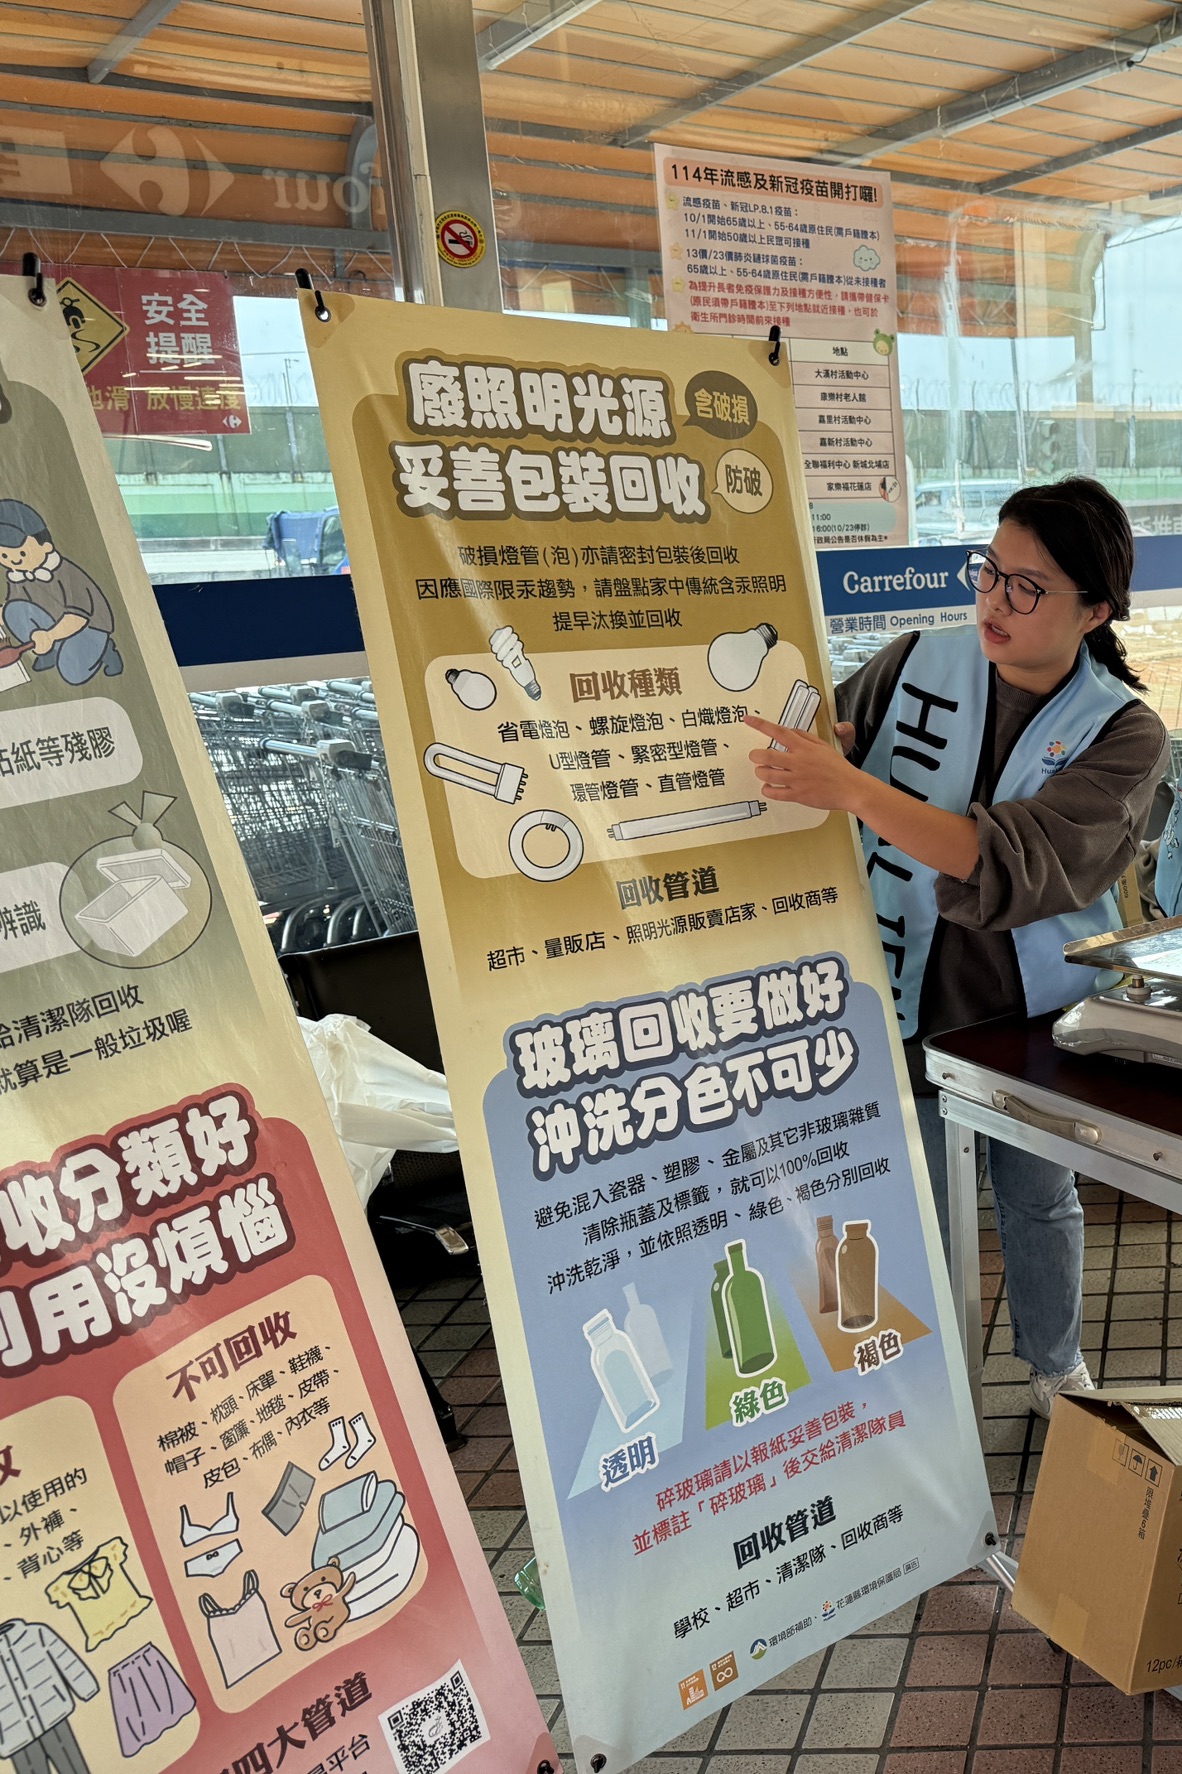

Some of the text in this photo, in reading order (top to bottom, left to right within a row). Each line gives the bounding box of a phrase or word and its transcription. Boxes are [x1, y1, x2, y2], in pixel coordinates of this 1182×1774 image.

[671, 163, 878, 203] 114年流感及新冠疫苗開打囉!
[141, 292, 209, 326] 安全
[146, 331, 215, 365] 提醒
[832, 346, 849, 357] 地點
[408, 359, 672, 439] 廢照明光源
[694, 388, 751, 426] 含破損
[394, 444, 706, 515] 妥善包裝回收
[725, 464, 763, 498] 防破
[458, 545, 740, 568] 破損燈管(泡)亦請密封包裝後回收
[842, 566, 949, 595] Carrefour
[552, 608, 683, 632] 提早汰換並回收
[830, 611, 968, 635] 營業時間 Opening Hours
[569, 667, 683, 703] 回收種類
[616, 866, 720, 910] 回收管道
[487, 886, 839, 972] 超市、量販店、照明光源販賣店家、回收商等
[514, 960, 844, 1090] 玻璃回收要做好
[533, 1030, 855, 1173] 沖洗分色不可少
[0, 1095, 251, 1257] 收分類好
[534, 1100, 881, 1230] 避免混入瓷器、塑膠、金屬及其它非玻璃雜質
[165, 1310, 298, 1403] 不可回收
[855, 1331, 902, 1373] 褐色
[732, 1379, 787, 1424] 綠色
[600, 1436, 656, 1488] 透明
[732, 1495, 837, 1570] 回收管道
[673, 1504, 904, 1640] 學校、超市、清潔隊、回收商等
[219, 1671, 372, 1774] 四大管道
